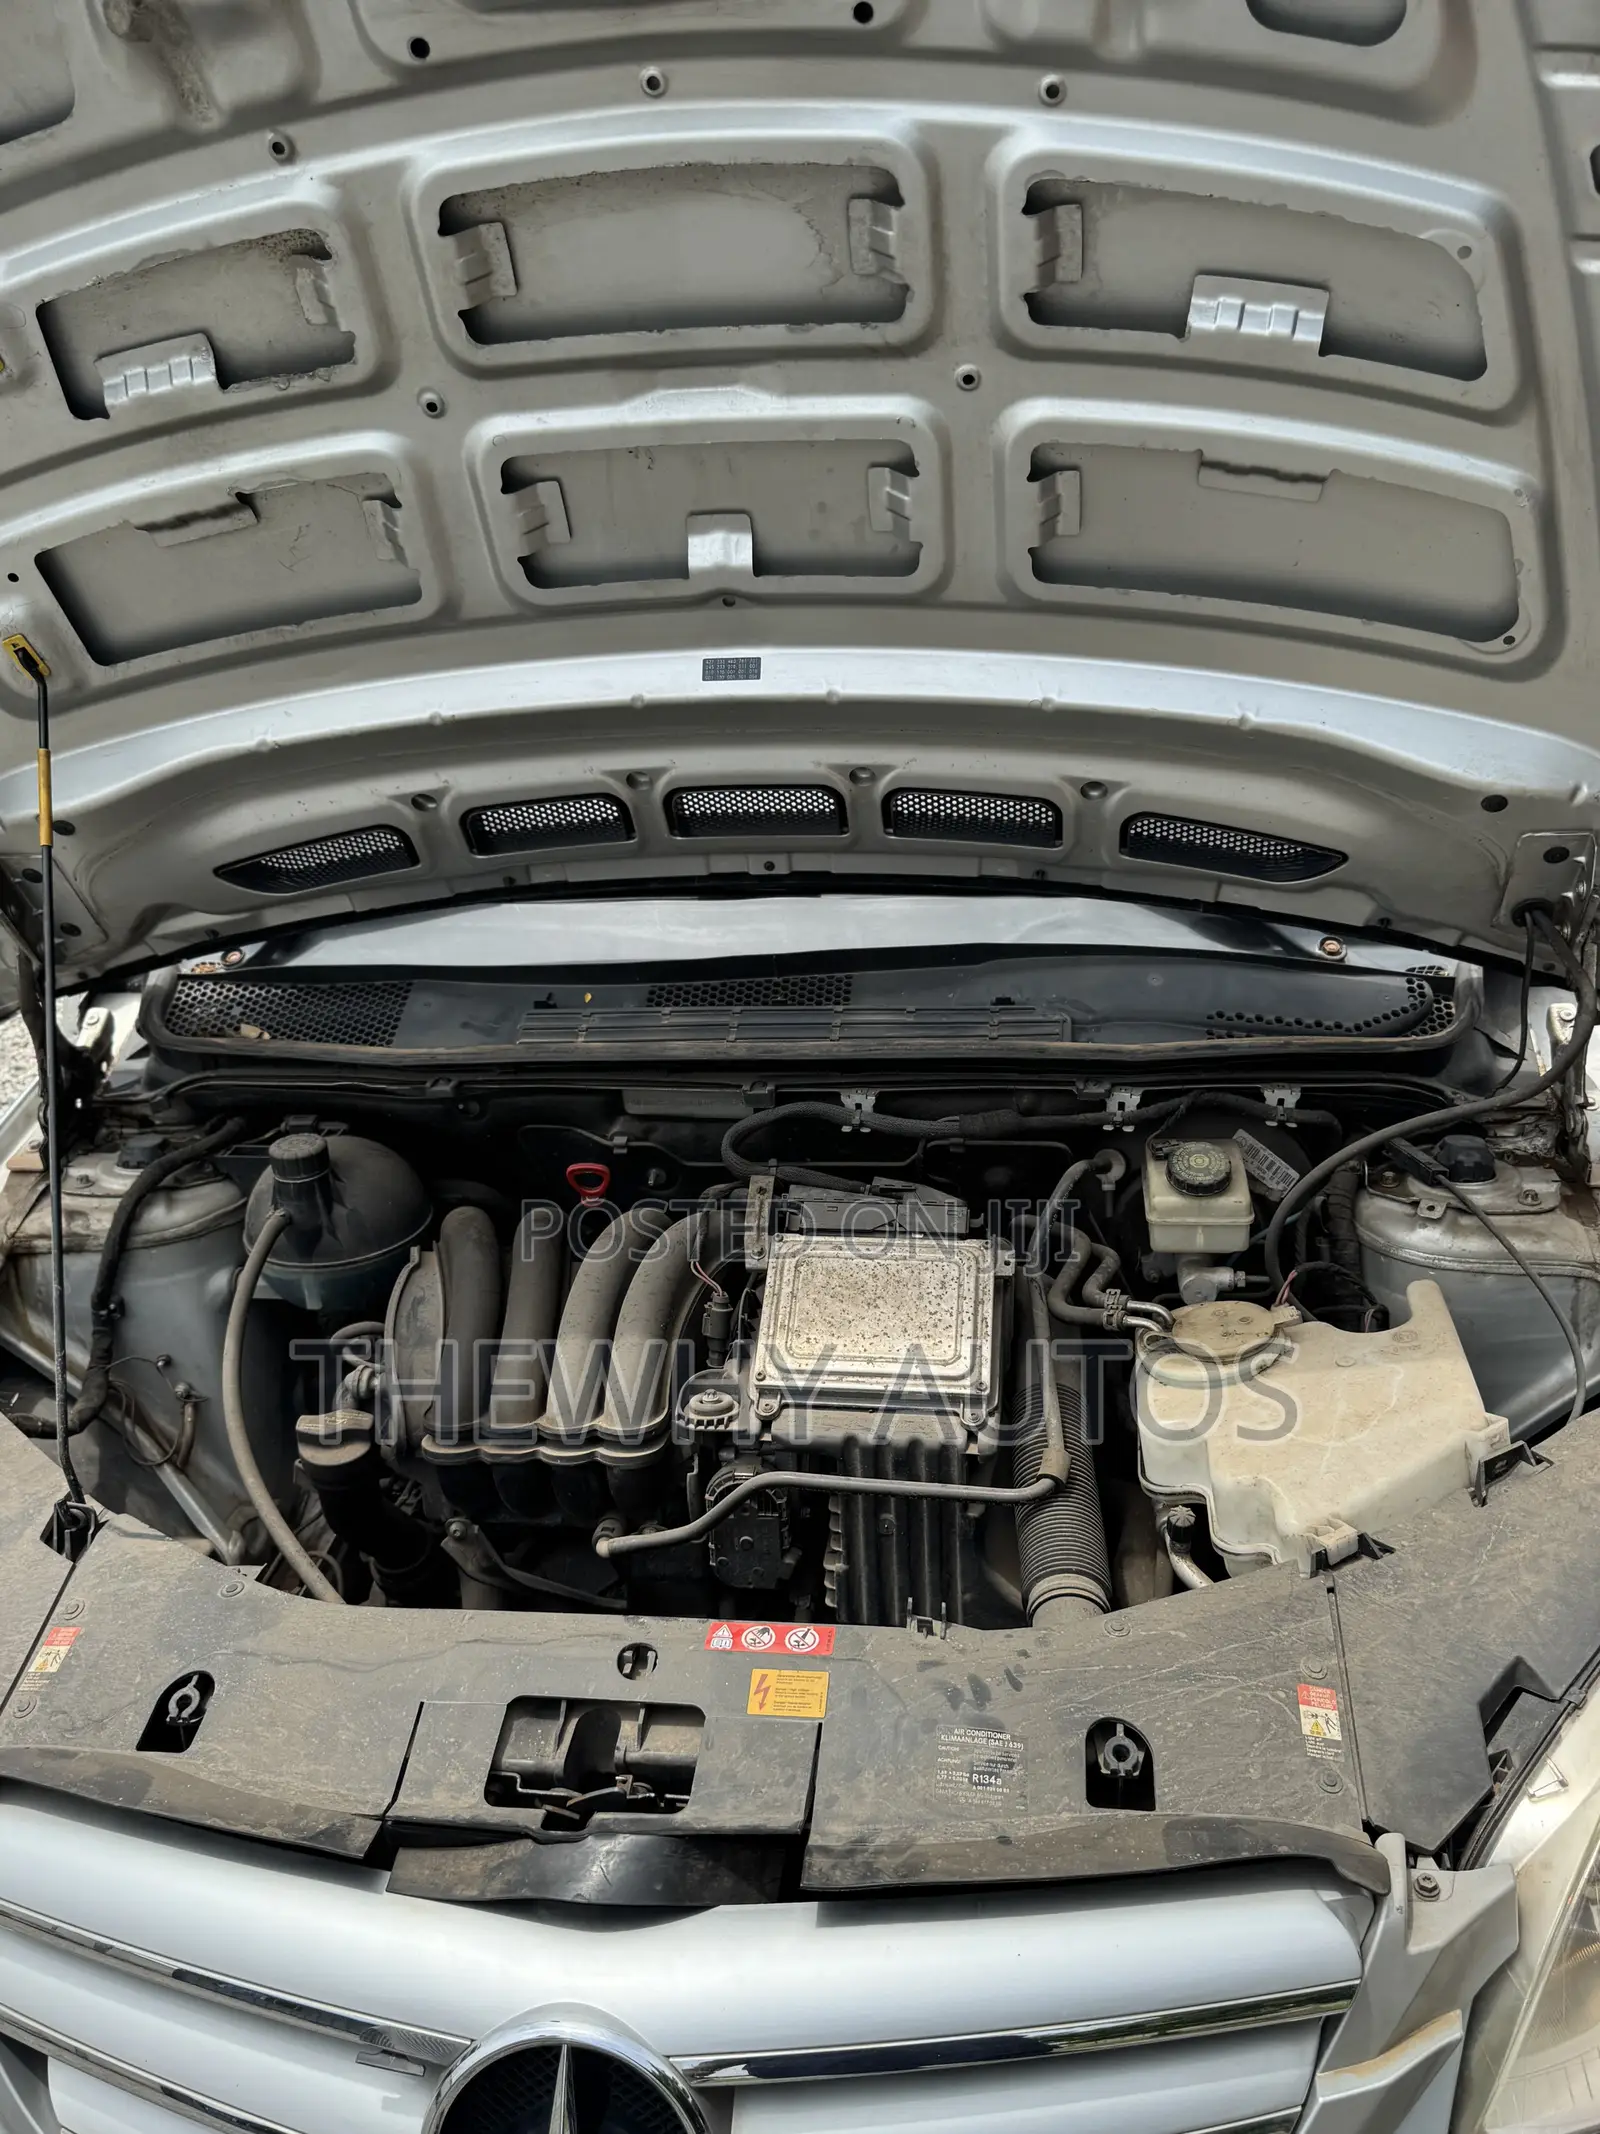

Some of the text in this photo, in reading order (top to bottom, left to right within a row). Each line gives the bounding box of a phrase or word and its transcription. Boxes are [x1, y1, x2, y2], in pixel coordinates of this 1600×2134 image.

[966, 1728, 1011, 1740] CONDITIONER
[941, 1734, 987, 1745] KLIMAANLAGE
[988, 1739, 1003, 1747] (SAE
[1009, 1741, 1024, 1750] 639)
[972, 1774, 1002, 1785] R134a
